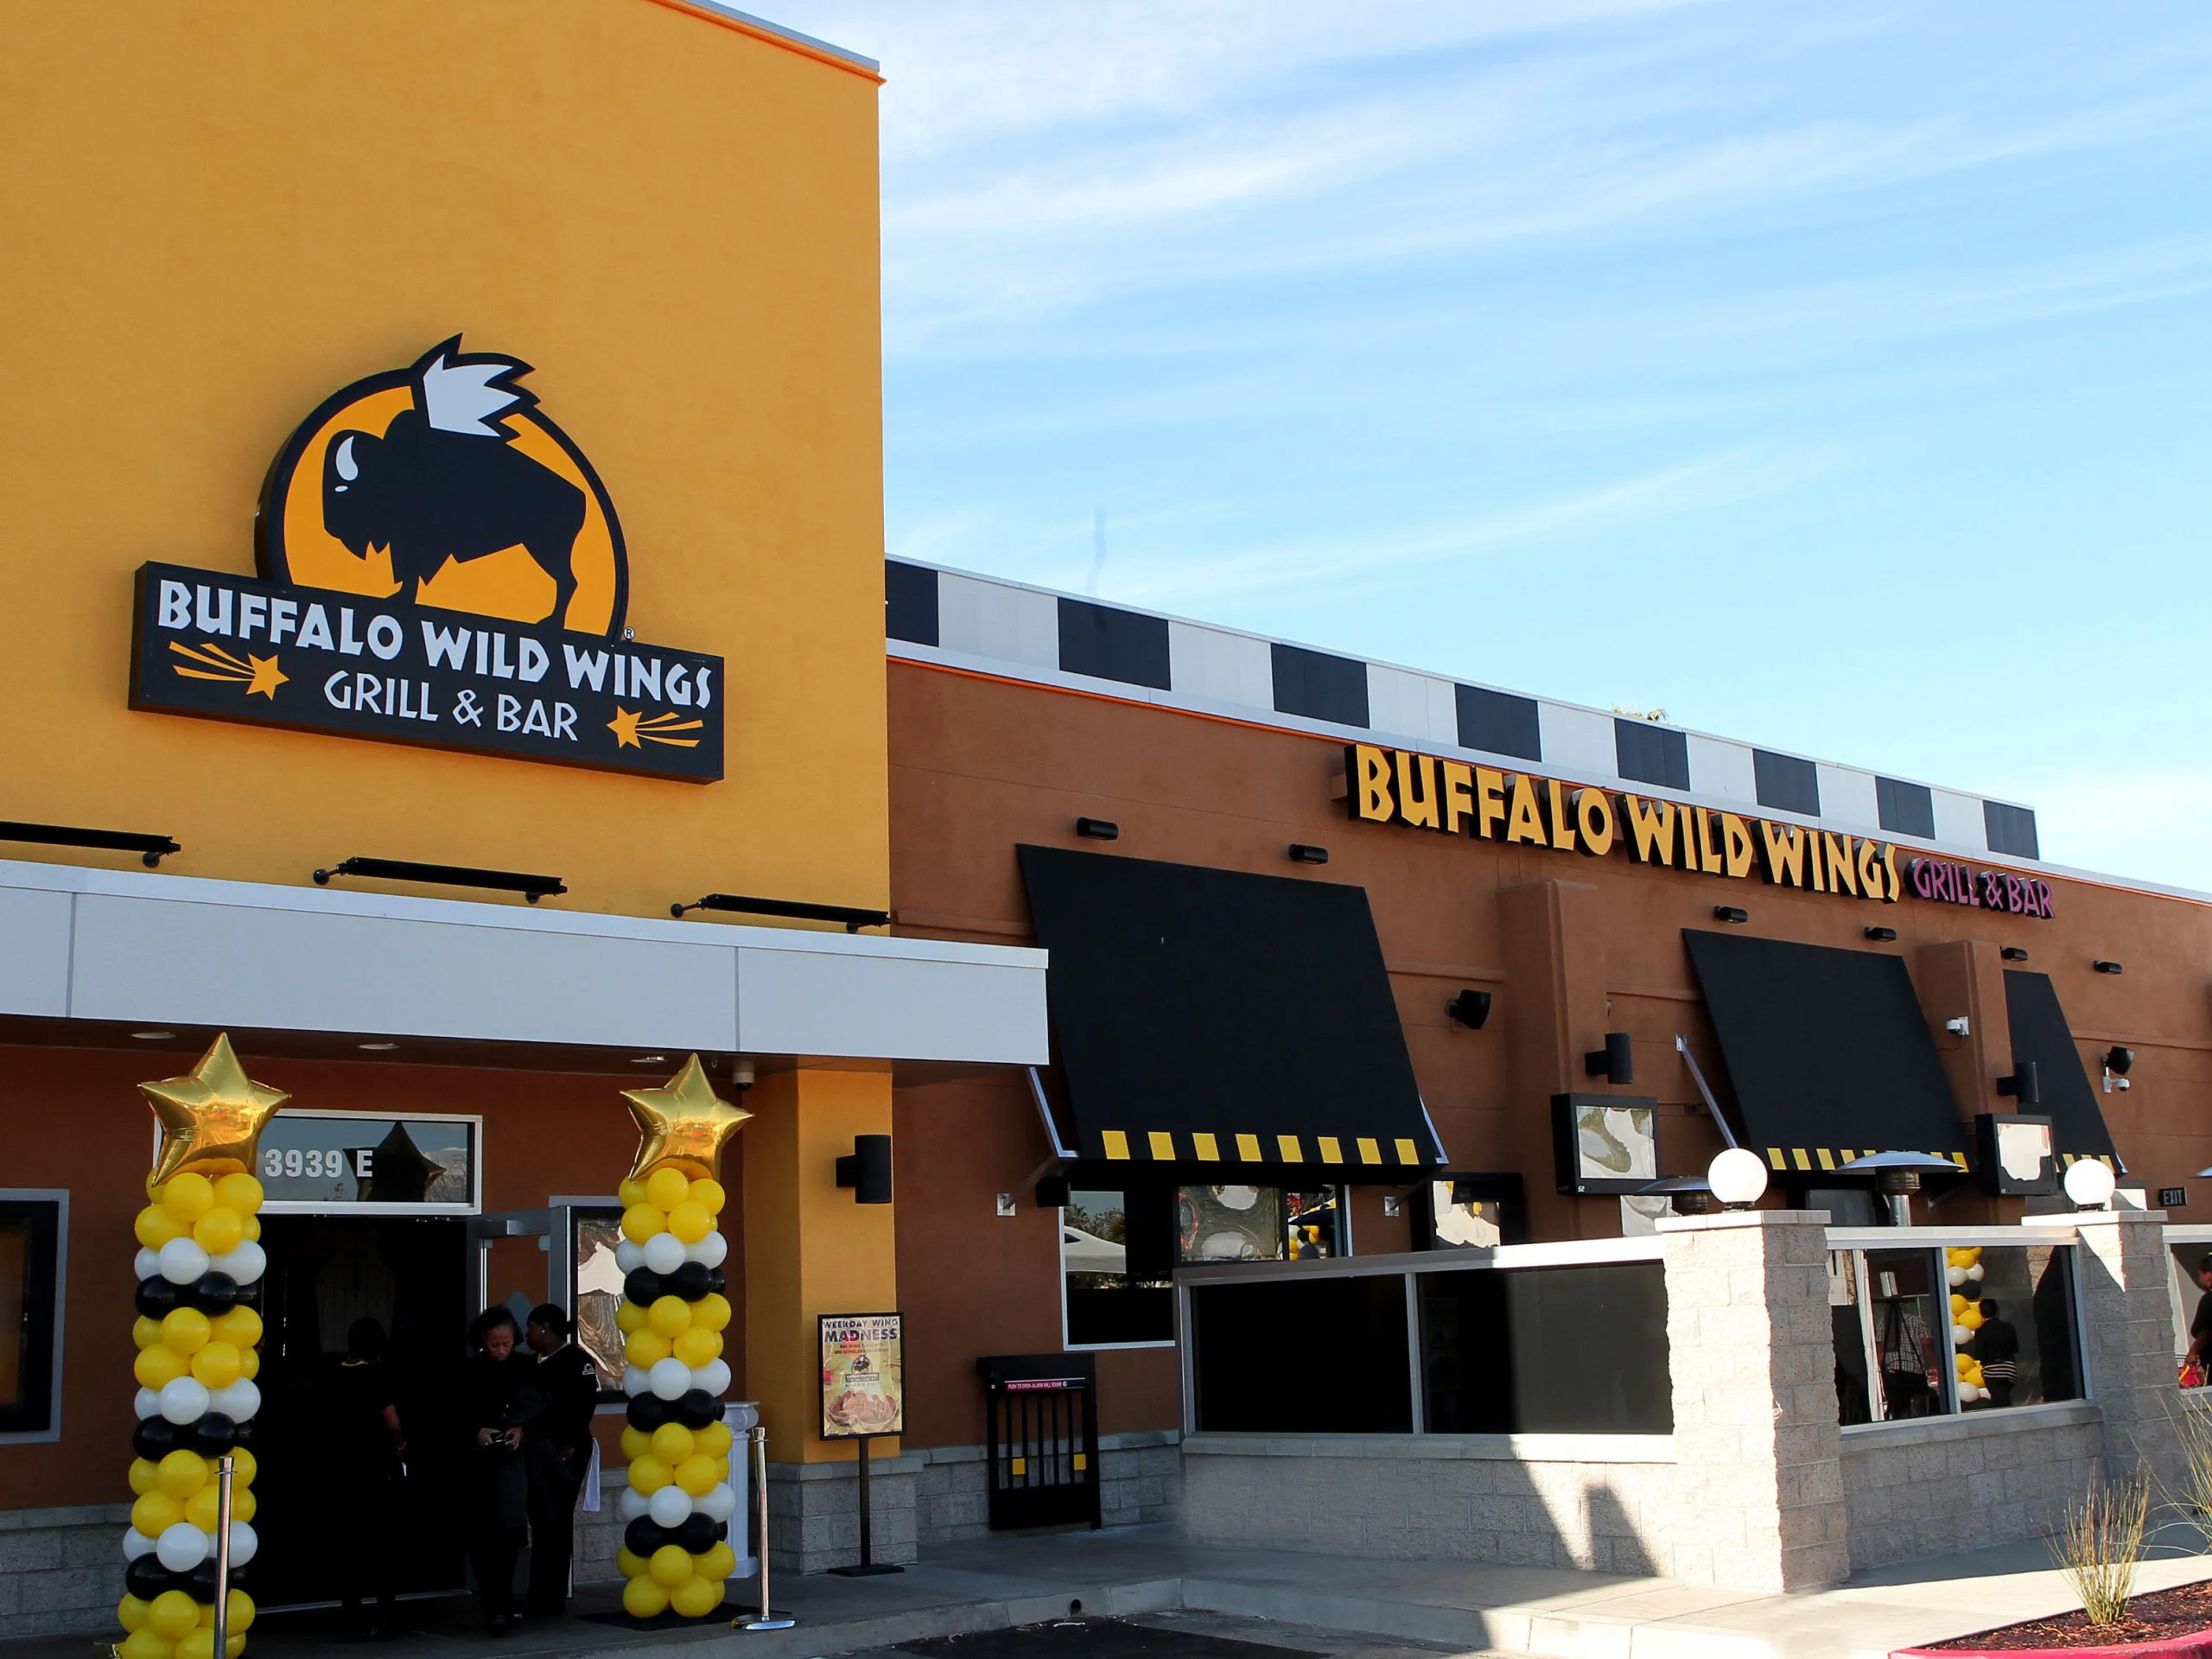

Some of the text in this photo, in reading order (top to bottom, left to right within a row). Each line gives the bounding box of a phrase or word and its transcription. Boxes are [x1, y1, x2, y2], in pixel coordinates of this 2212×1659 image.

[158, 579, 712, 709] BUFFALO WILD WINGS
[324, 670, 578, 741] GRILL & BAR
[1356, 743, 2055, 919] BUFFALO WILD WINGS GRILL & BAR
[264, 1148, 374, 1178] 3939 E
[2163, 1190, 2183, 1205] EXIT
[823, 1319, 899, 1329] WEEKDAY WING
[824, 1328, 899, 1342] MADNESS
